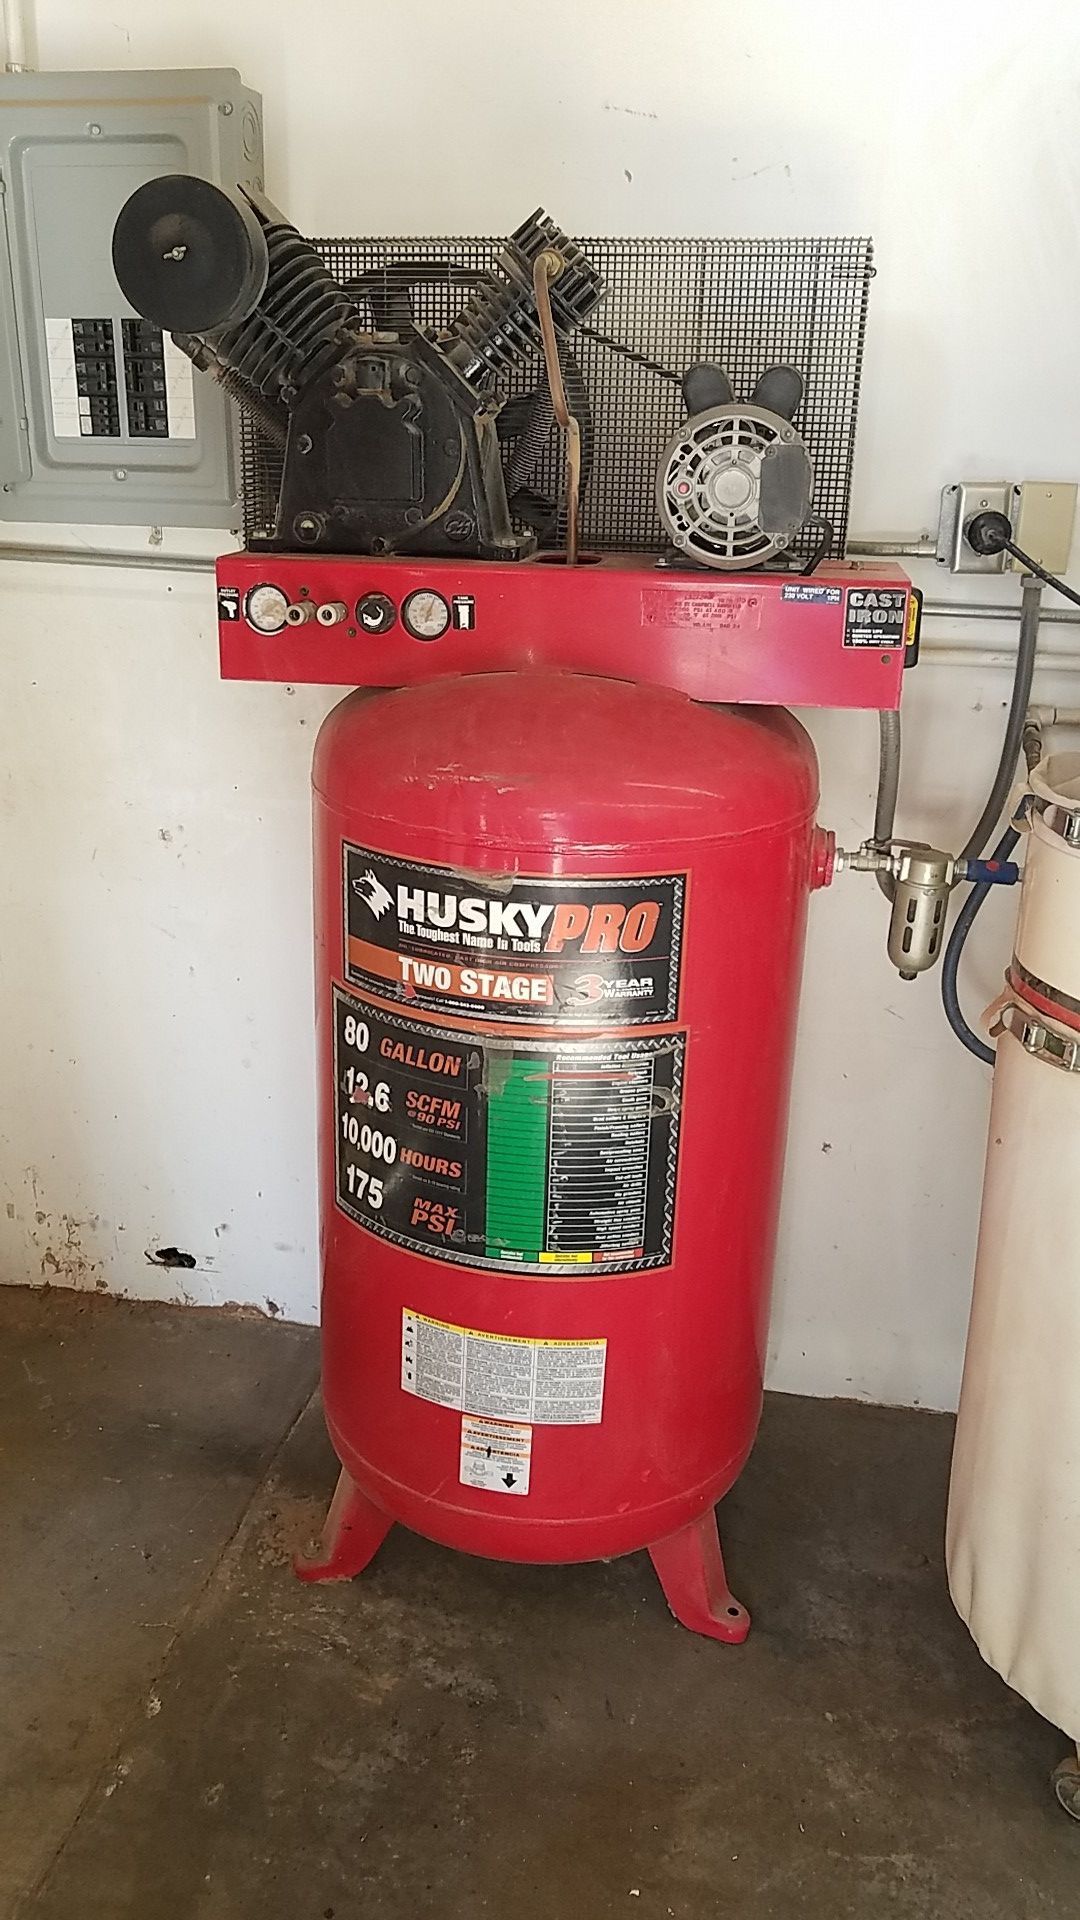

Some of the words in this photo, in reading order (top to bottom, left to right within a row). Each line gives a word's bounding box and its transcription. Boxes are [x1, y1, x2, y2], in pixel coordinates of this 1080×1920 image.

[849, 592, 906, 608] CAST
[848, 609, 905, 624] IRON
[397, 885, 554, 938] HUSKY
[544, 901, 661, 953] PRO
[398, 919, 415, 934] The
[415, 924, 460, 944] Toughest
[462, 932, 494, 948] Name
[497, 937, 508, 951] In
[398, 956, 452, 990] TWO
[459, 969, 548, 1002] STAGE
[566, 973, 605, 1006] 3
[603, 977, 654, 988] YEAR
[344, 1015, 370, 1053] 80
[380, 1037, 462, 1077] GALLON
[405, 1090, 462, 1119] SCFM
[437, 1116, 462, 1132] PSI
[341, 1111, 397, 1165] 10,000
[400, 1147, 462, 1179] HOURS
[346, 1163, 385, 1210] 175
[413, 1197, 459, 1218] MAX
[411, 1209, 456, 1236] PSI
[422, 1317, 450, 1330] WARNING
[477, 1332, 531, 1344] AVERTISSEMENT
[472, 1430, 525, 1442] AVERTISSEMENT
[484, 1420, 515, 1429] WARNING
